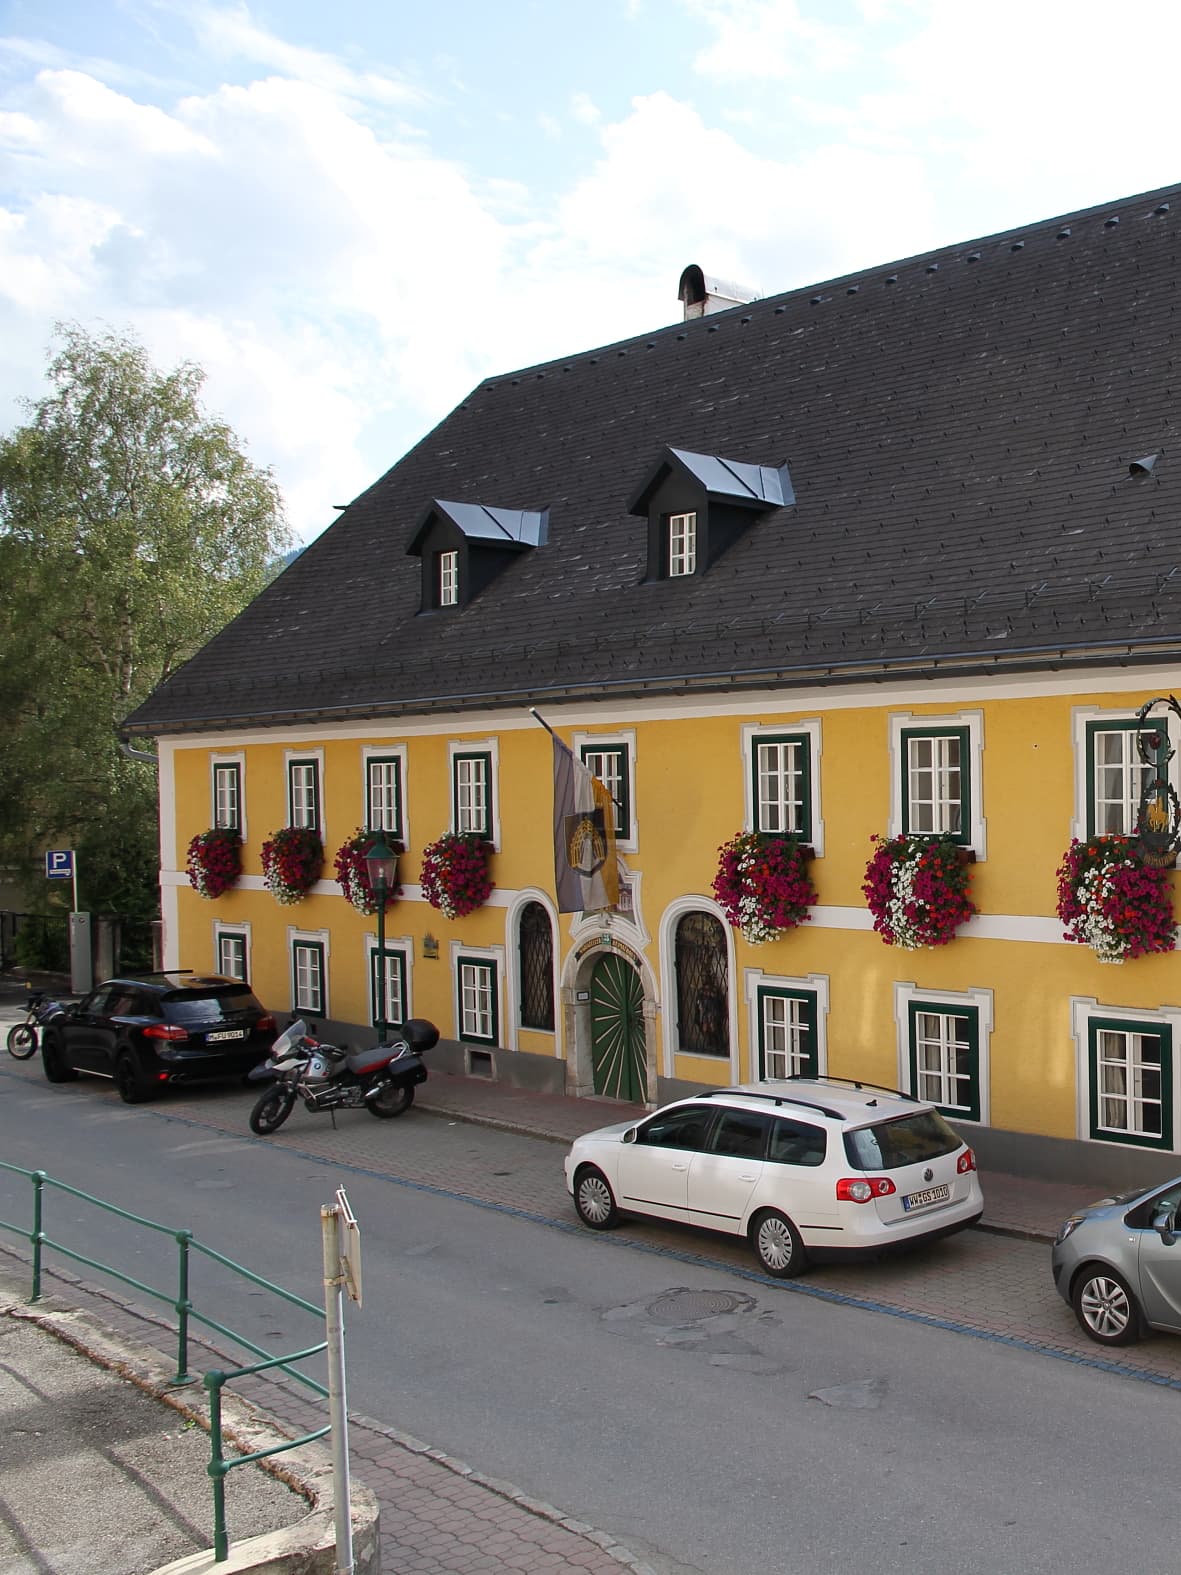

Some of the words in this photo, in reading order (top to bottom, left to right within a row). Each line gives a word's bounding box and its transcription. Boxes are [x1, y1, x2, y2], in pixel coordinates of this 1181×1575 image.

[53, 853, 66, 868] P
[922, 1191, 931, 1202] GS
[932, 1187, 948, 1199] 1010
